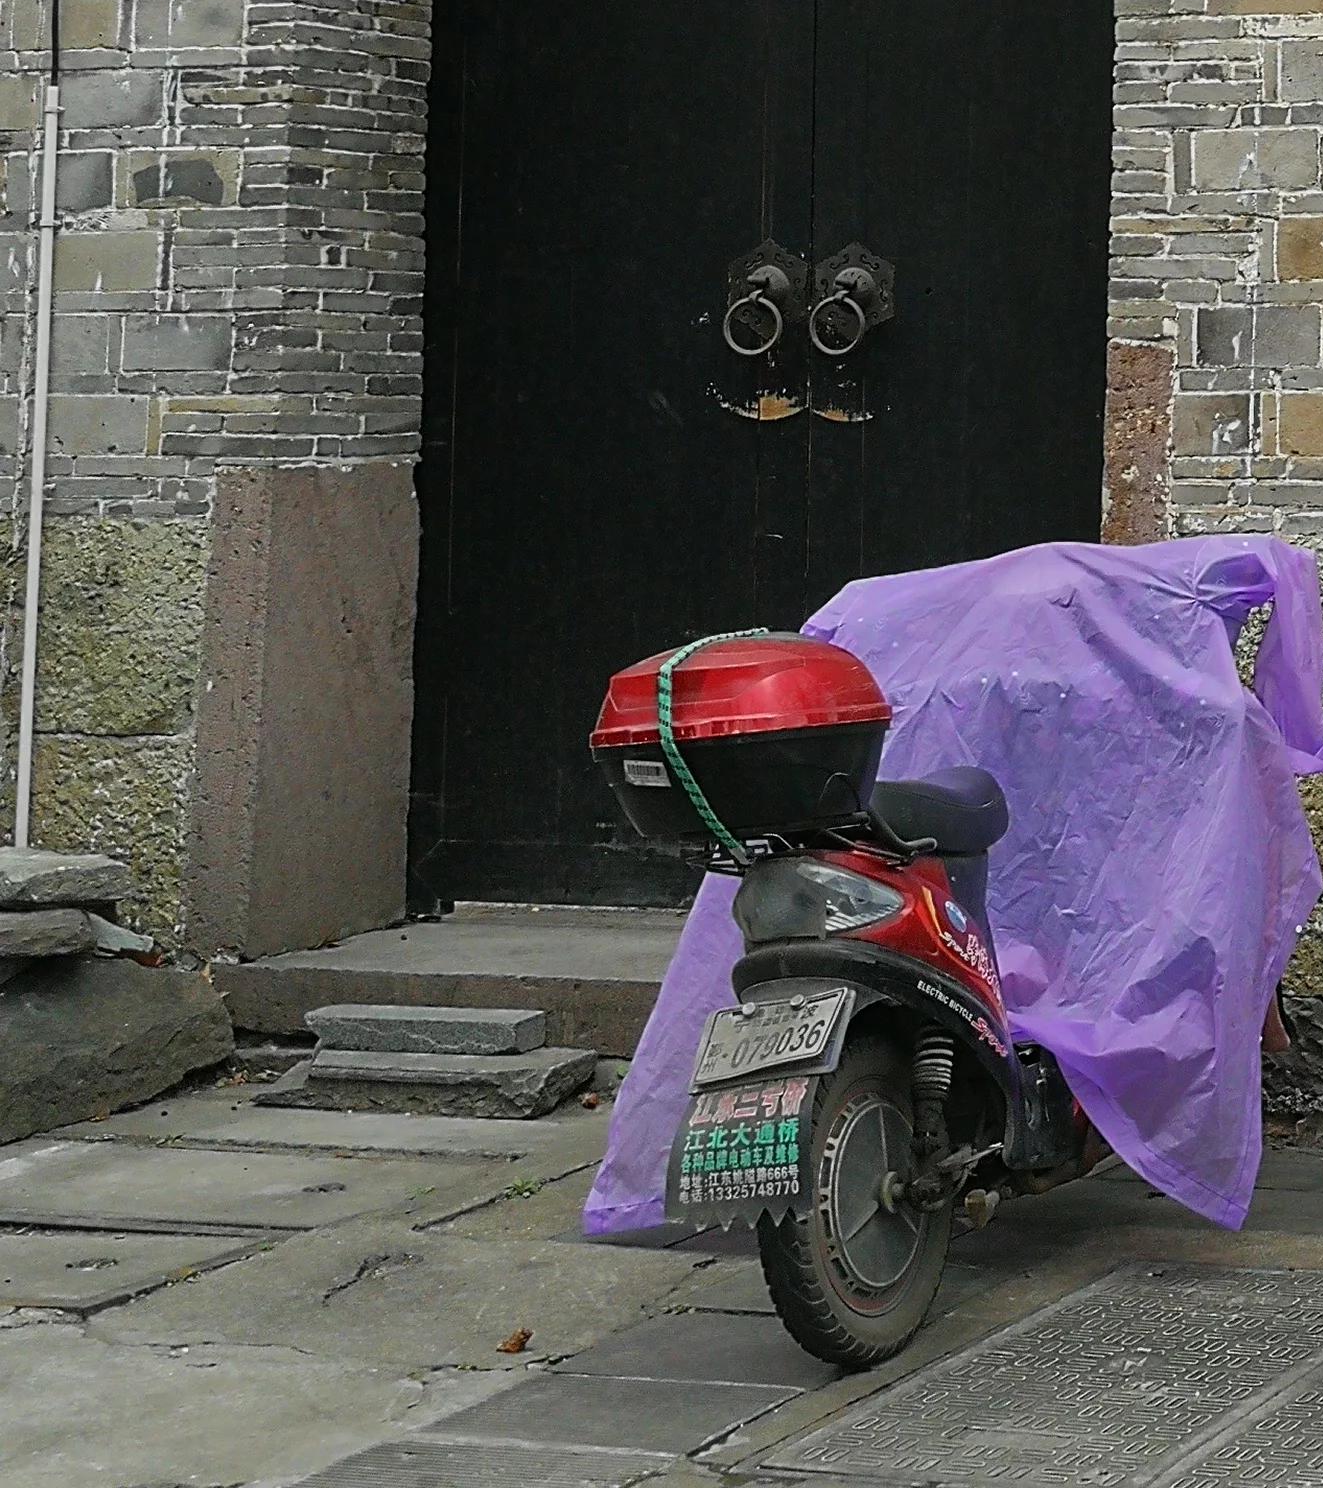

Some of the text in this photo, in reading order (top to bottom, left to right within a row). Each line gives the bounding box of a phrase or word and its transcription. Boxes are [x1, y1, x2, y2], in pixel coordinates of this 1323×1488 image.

[917, 980, 973, 1021] ELECTRIC BICYCLE
[684, 1118, 800, 1152] 江北大通桥
[681, 1143, 799, 1174] 各种品牌电动车及维修
